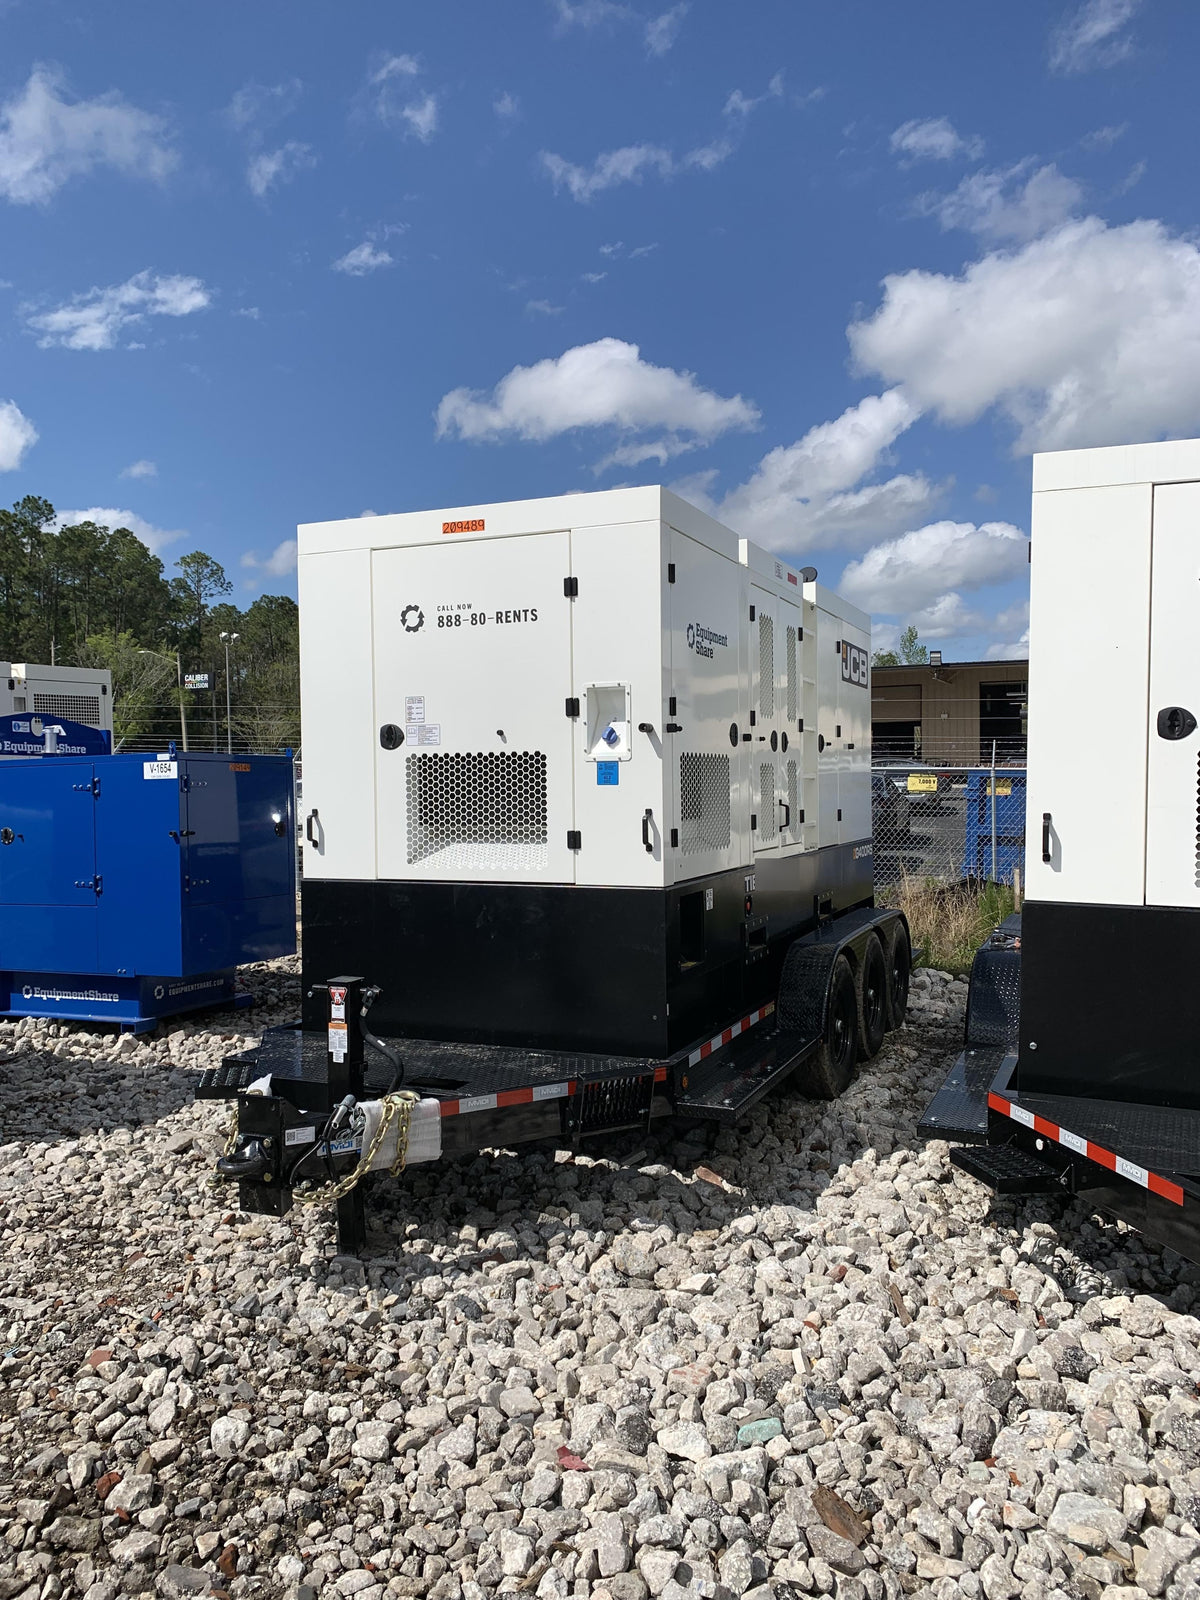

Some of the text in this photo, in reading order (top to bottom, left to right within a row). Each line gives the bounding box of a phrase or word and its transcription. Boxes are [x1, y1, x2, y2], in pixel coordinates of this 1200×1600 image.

[442, 519, 485, 534] 209489
[457, 603, 473, 611] NOW
[437, 608, 538, 628] 888-80-RENTS
[696, 622, 728, 647] Equipment
[696, 640, 714, 659] Share
[842, 643, 868, 686] JCB
[184, 673, 209, 682] CALIBER
[149, 763, 172, 774] V-1654
[33, 986, 120, 1002] EquipmentShare
